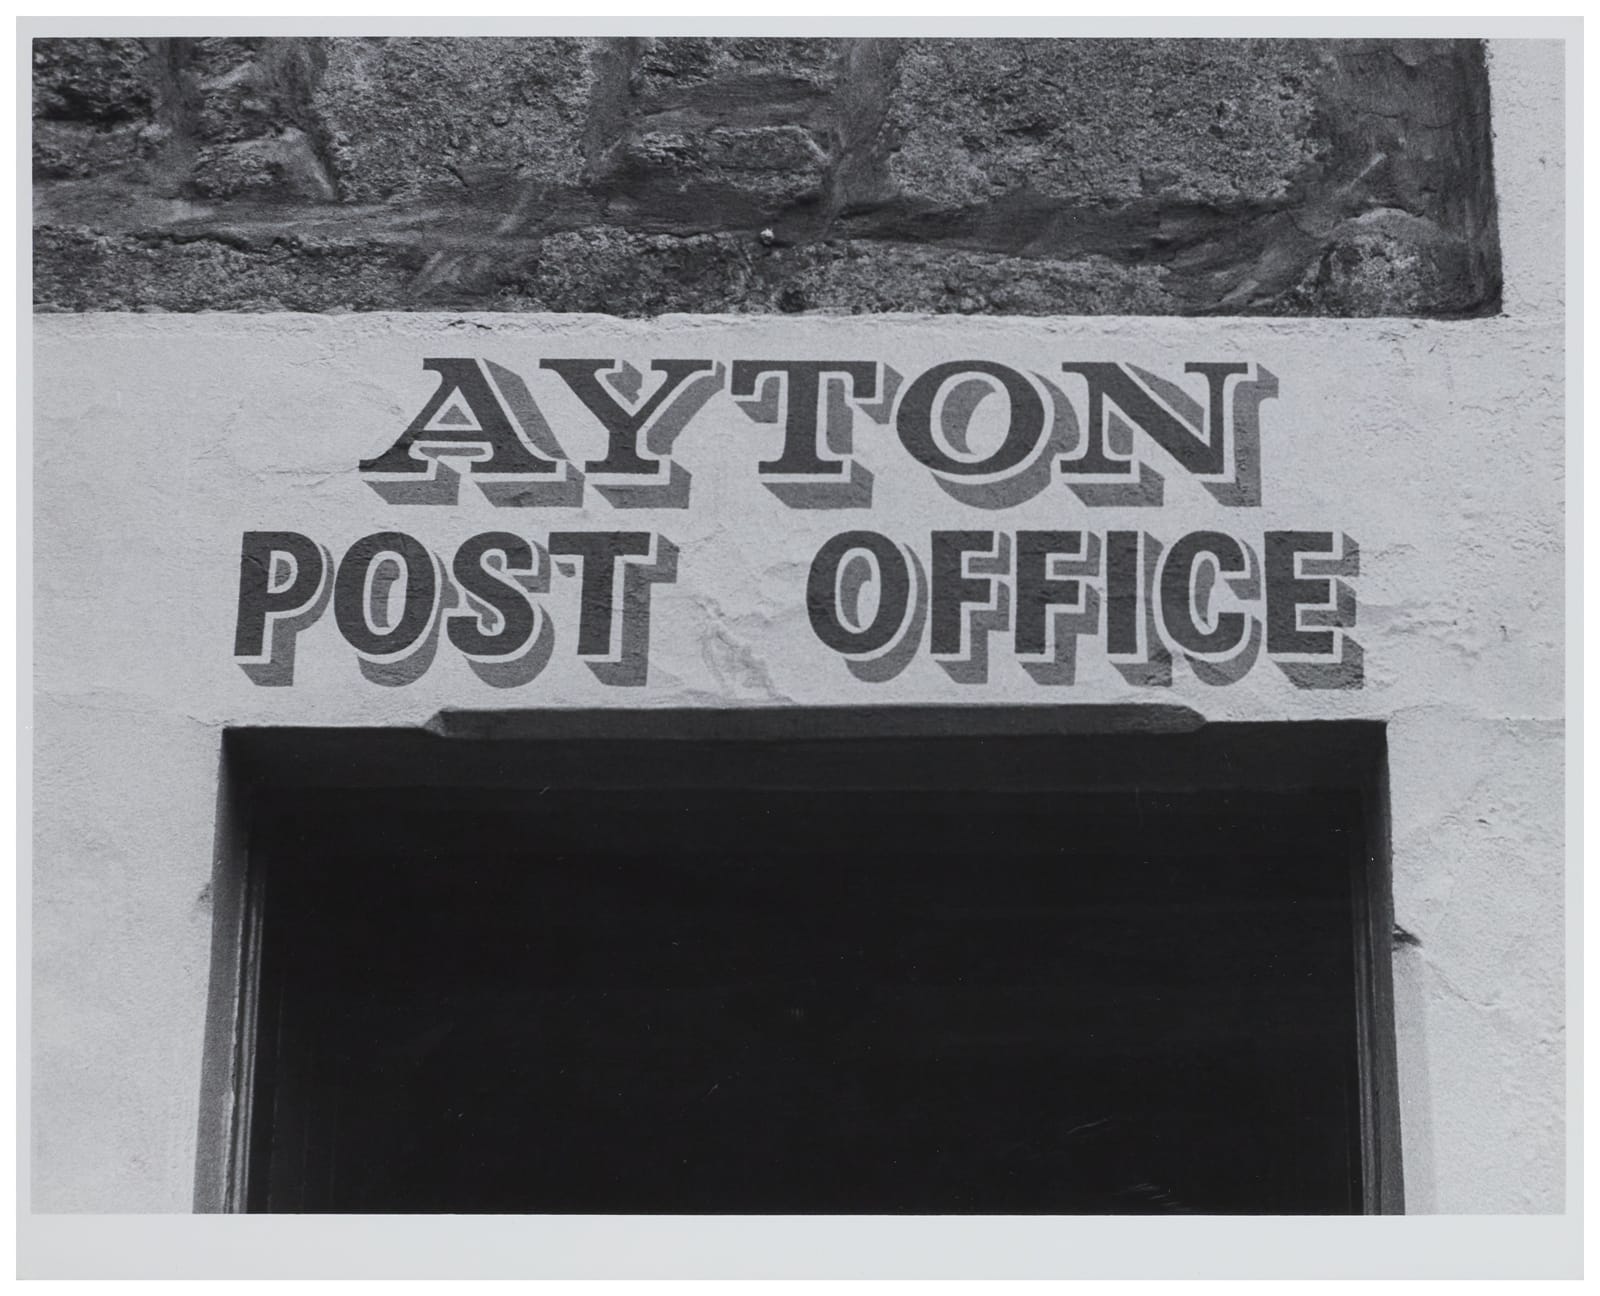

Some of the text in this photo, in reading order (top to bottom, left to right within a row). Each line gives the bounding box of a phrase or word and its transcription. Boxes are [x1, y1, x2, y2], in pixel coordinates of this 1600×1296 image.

[360, 357, 1280, 509] AYTON
[233, 530, 1365, 689] POST OFFICE
